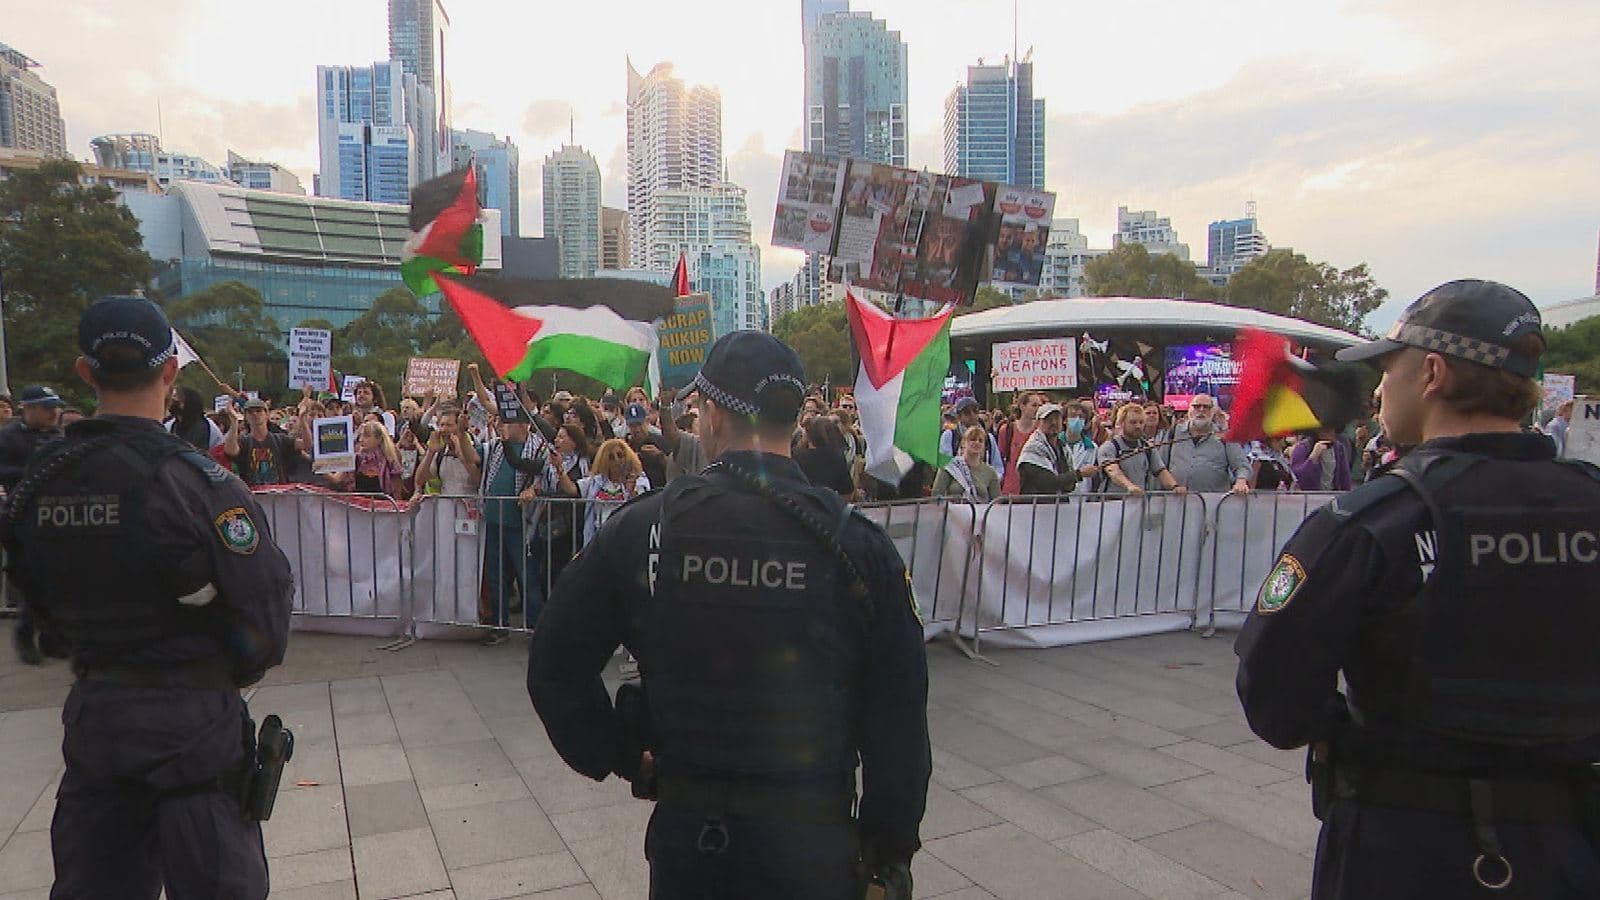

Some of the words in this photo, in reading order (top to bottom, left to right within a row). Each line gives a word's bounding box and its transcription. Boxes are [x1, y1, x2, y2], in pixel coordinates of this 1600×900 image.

[661, 329, 709, 348] AUKUS
[669, 348, 705, 367] NOW
[1000, 344, 1068, 360] SEPARATE
[1000, 358, 1067, 372] WEAPONS
[994, 376, 1027, 389] FROM
[1032, 375, 1074, 388] PROFIT
[38, 503, 120, 527] POLICE
[1469, 530, 1600, 567] POLIC
[682, 554, 807, 590] POLICE
